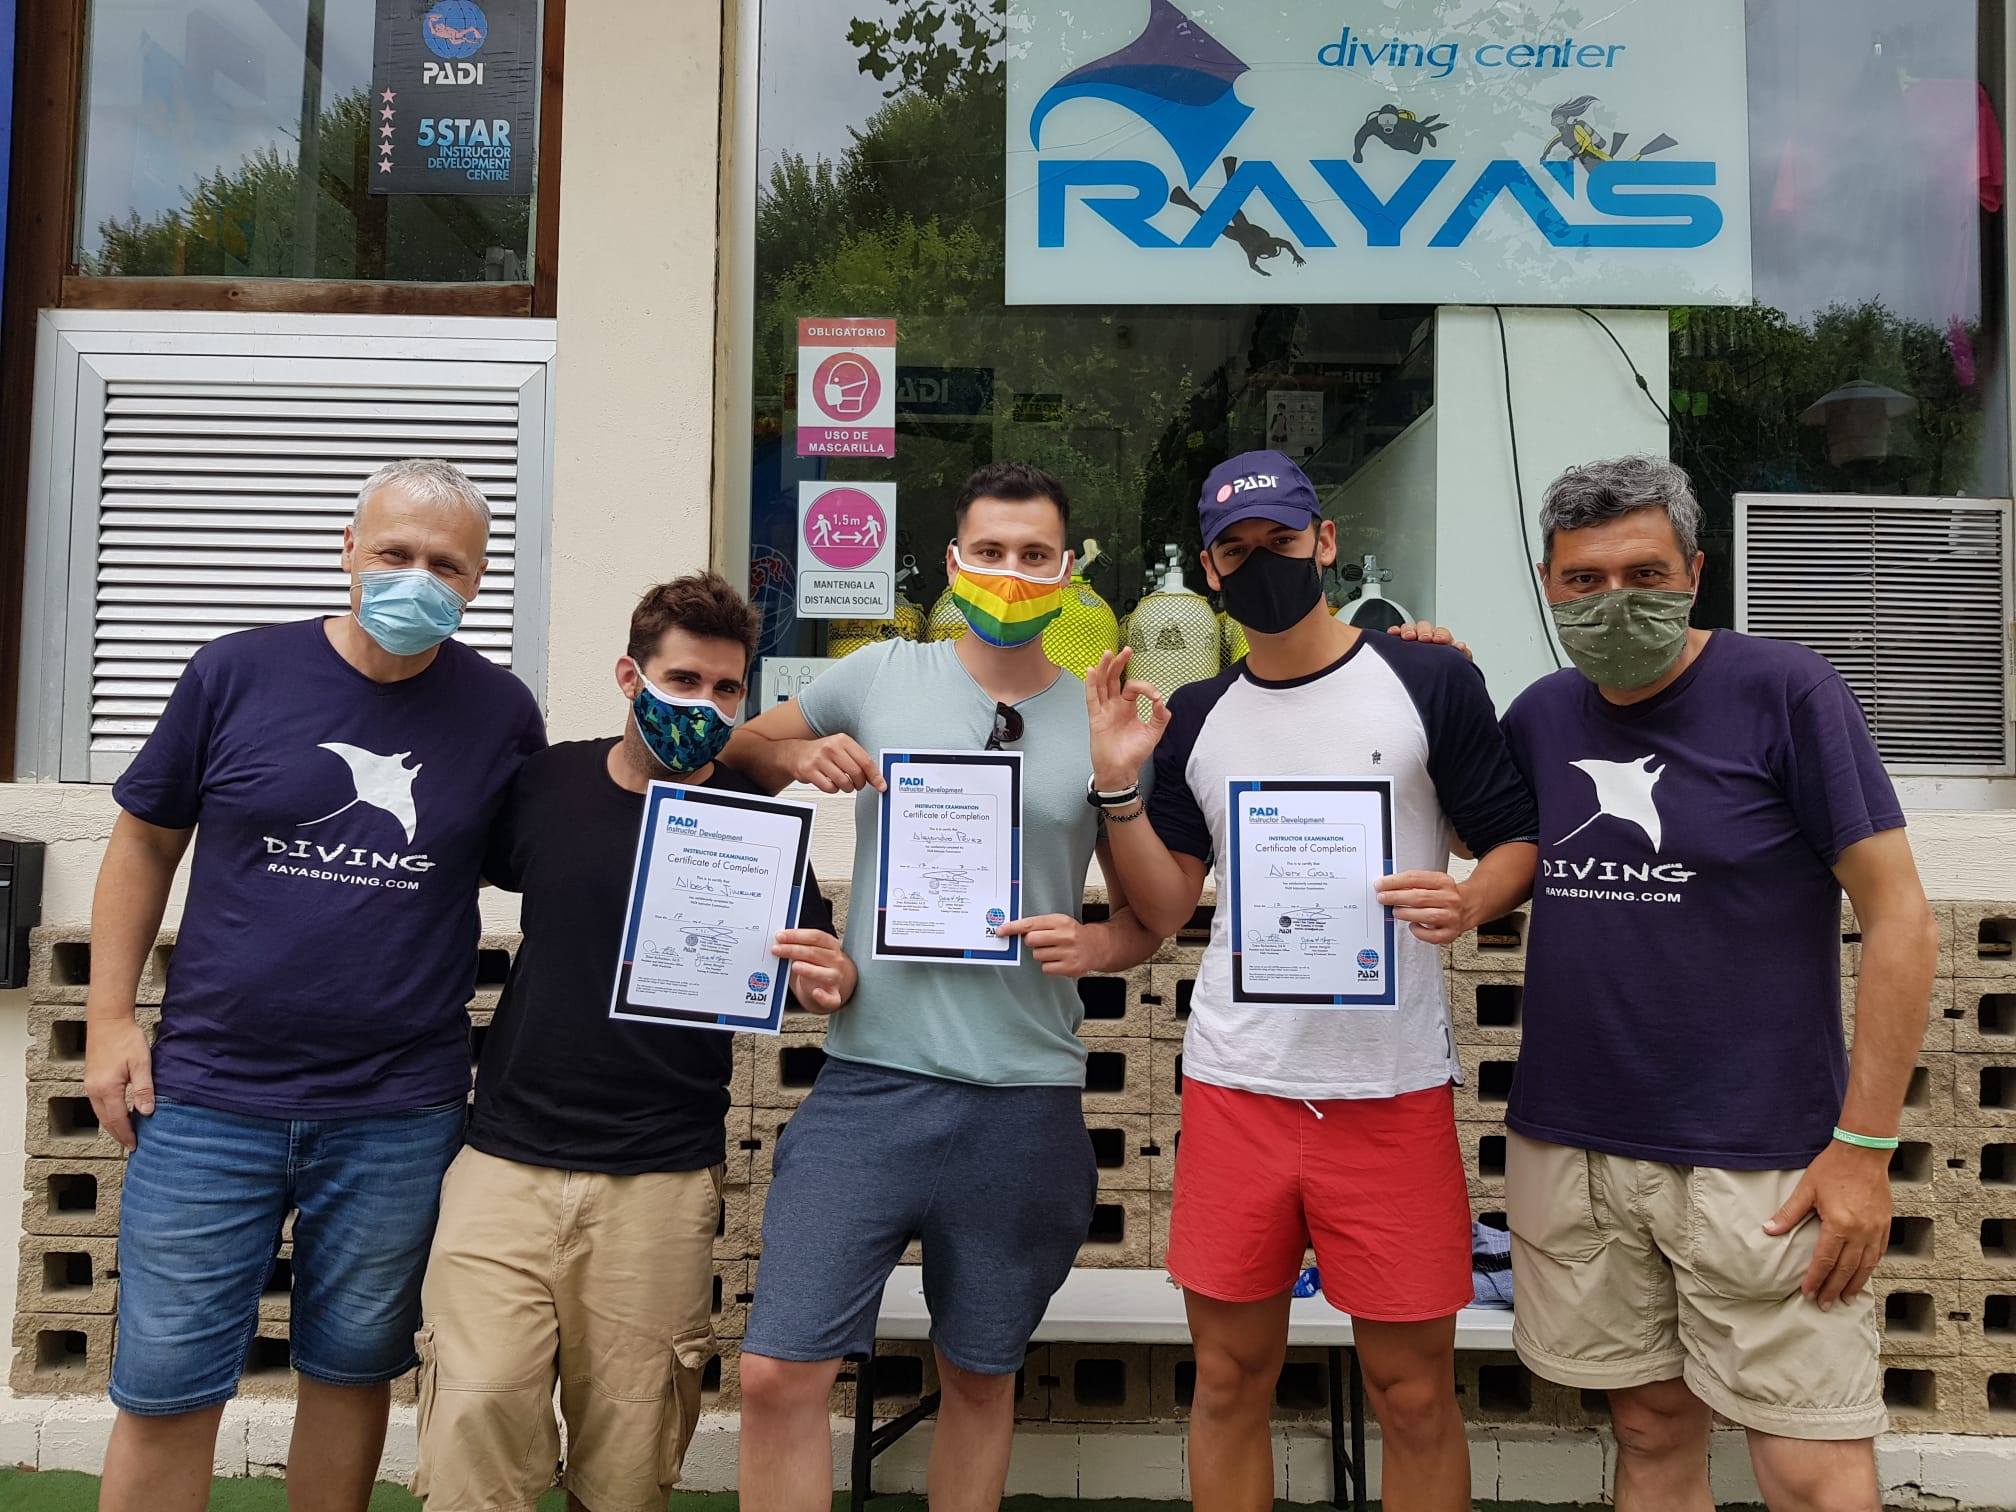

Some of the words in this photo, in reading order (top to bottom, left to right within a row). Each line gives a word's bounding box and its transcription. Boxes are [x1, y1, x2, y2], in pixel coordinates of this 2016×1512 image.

[1317, 26, 1466, 79] diving
[1475, 38, 1627, 70] center
[423, 62, 485, 85] PADI
[439, 146, 511, 158] INSTRUCTOR
[427, 157, 512, 169] DEVELOPMENT
[466, 169, 510, 181] CENTRE
[807, 327, 886, 338] OBLIGATORIO
[895, 377, 949, 404] ADI
[824, 431, 850, 441] USO
[853, 431, 869, 441] DE
[808, 443, 885, 454] MASCARILLA
[1233, 474, 1279, 494] PADI
[813, 580, 863, 590] MANTENGA
[864, 581, 876, 590] LA
[804, 595, 851, 605] DISTANCIA
[852, 596, 884, 606] SOCIAL
[899, 777, 924, 786] PADI
[926, 786, 963, 794] Development
[903, 810, 939, 819] Certificate
[940, 810, 948, 819] of
[949, 811, 990, 822] Completion
[1249, 807, 1278, 816] PADI
[667, 815, 698, 828] PADI
[1248, 816, 1278, 824] Instructor
[1280, 816, 1325, 825] Development
[666, 824, 697, 835] Instructor
[699, 828, 743, 841] Development
[263, 836, 437, 873] DIVING
[683, 847, 718, 857] INSTRUCTOR
[719, 852, 758, 862] EXAMINATION
[1255, 843, 1297, 853] Certificate
[1299, 843, 1308, 853] of
[1309, 843, 1357, 855] Completion
[667, 853, 710, 867] Certificate
[712, 859, 722, 869] of
[722, 861, 769, 876] Completion
[1542, 857, 1697, 883] DIVING
[267, 863, 420, 890] RAYASDIVING.COM
[1545, 887, 1681, 903] RAYASDIVING.COM
[1357, 970, 1379, 978] PADI
[745, 992, 767, 1002] PADI
